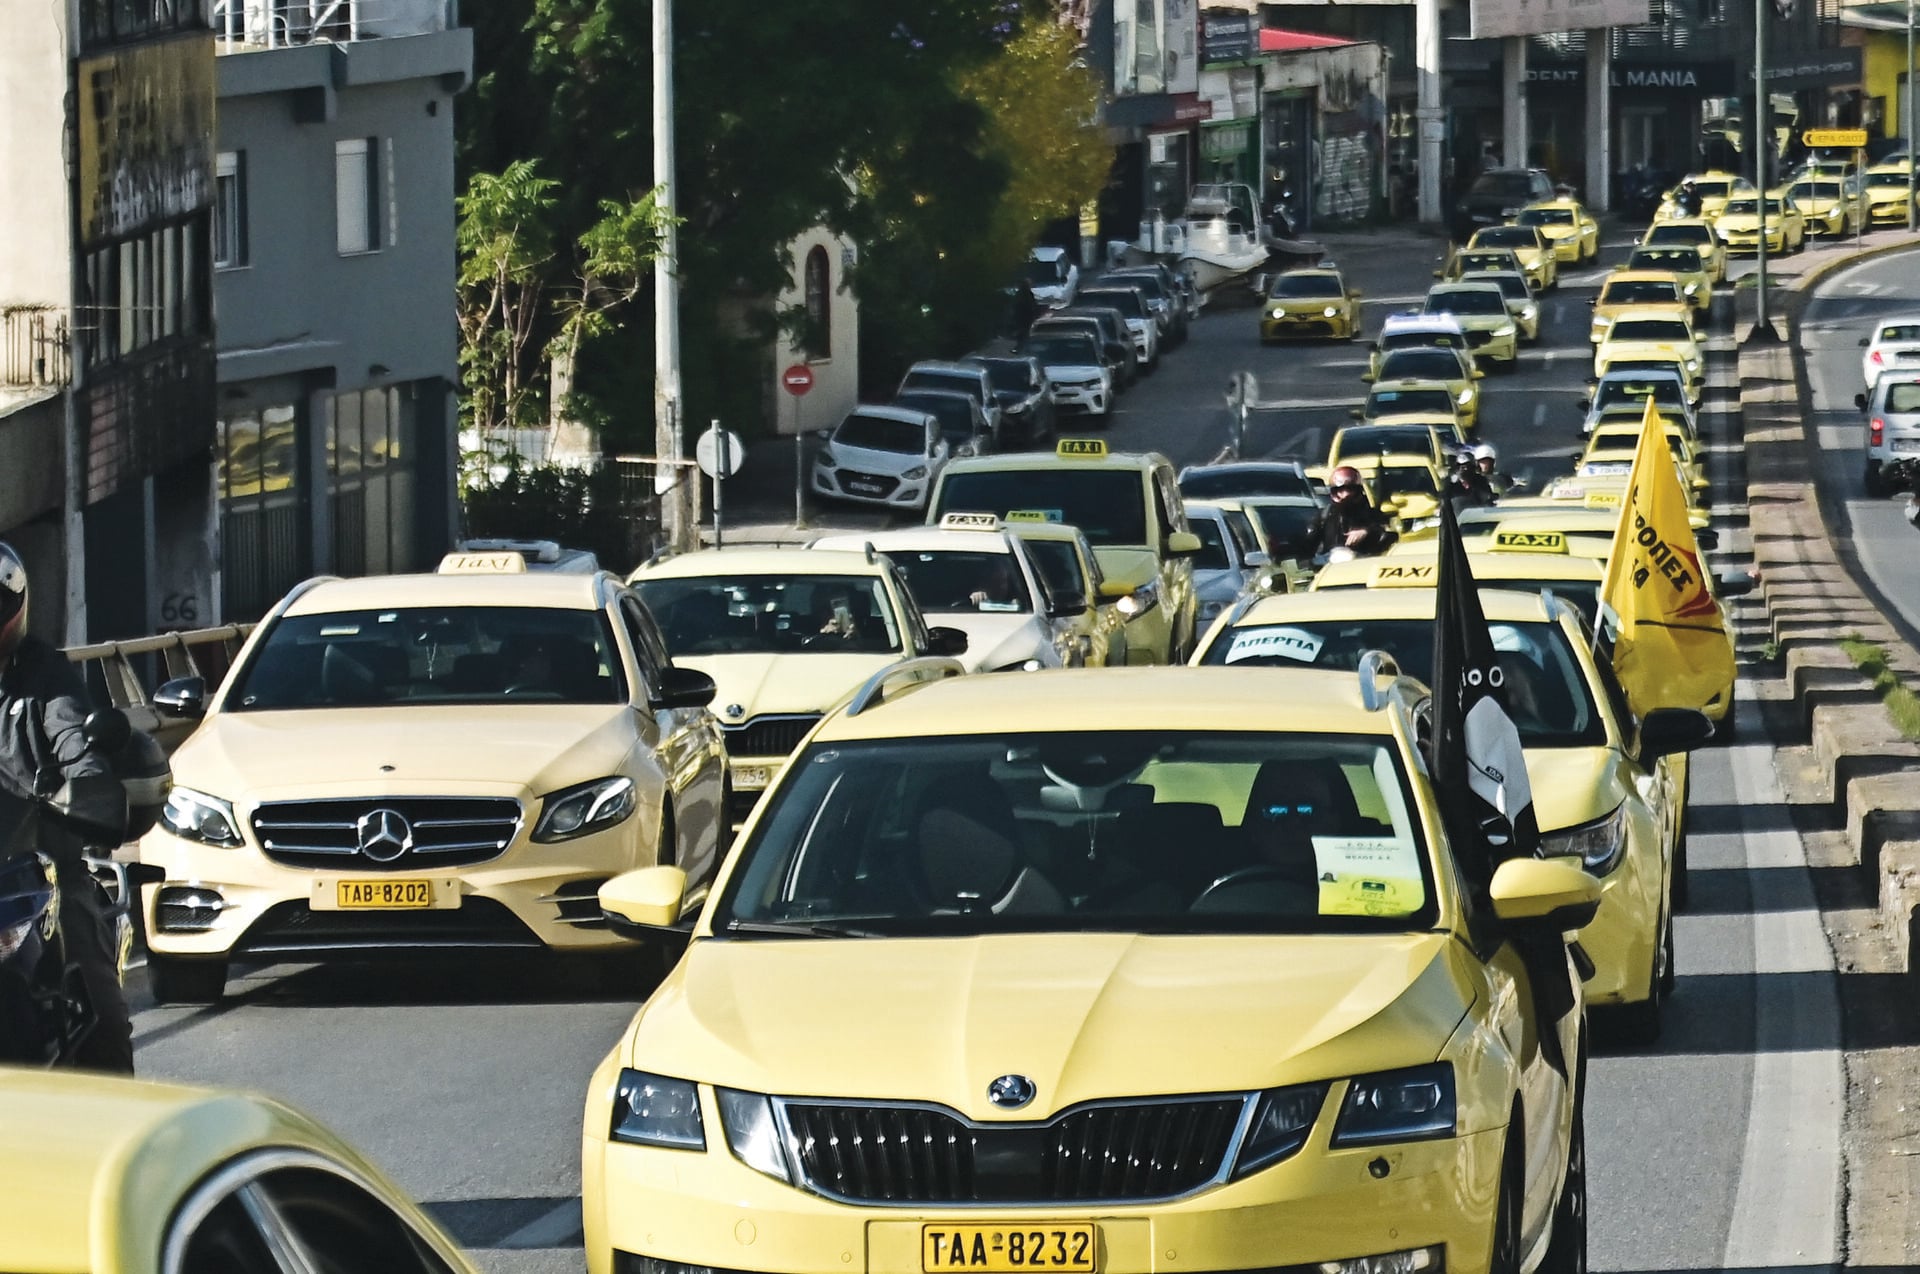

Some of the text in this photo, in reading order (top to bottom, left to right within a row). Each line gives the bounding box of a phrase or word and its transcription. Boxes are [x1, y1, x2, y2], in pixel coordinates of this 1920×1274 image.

[1627, 71, 1697, 87] MANIA
[1064, 441, 1099, 453] TAXI
[951, 515, 994, 525] TAXI
[1501, 534, 1558, 546] TAXI
[450, 557, 510, 569] Taxi
[1378, 566, 1433, 579] TAXI
[161, 592, 198, 622] 66
[1235, 635, 1316, 652] ΑΠΕΡΓΙΑ
